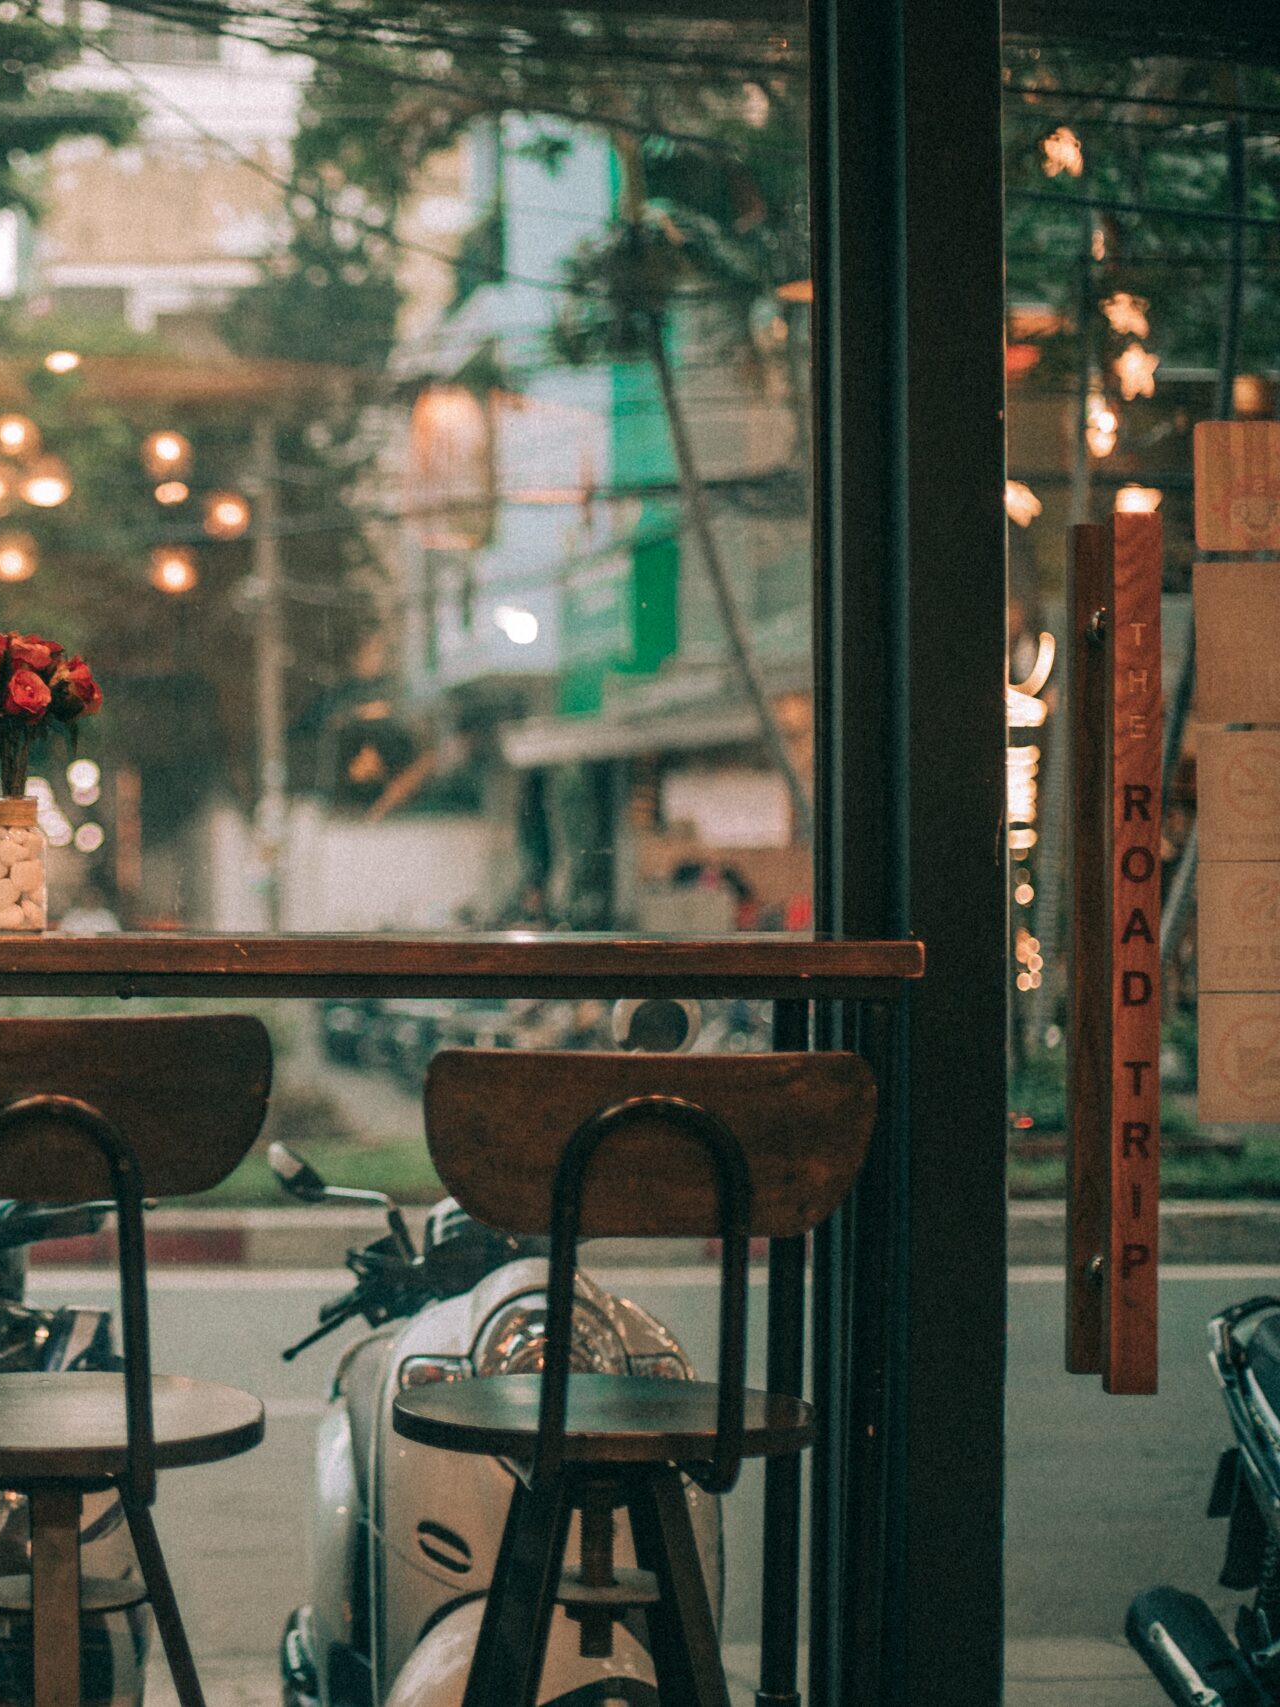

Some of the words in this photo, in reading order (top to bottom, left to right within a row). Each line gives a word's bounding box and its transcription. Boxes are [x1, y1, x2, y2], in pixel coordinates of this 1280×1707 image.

[1128, 622, 1148, 739] THE
[1121, 783, 1155, 1007] ROAD
[1121, 1060, 1152, 1280] TRIP
